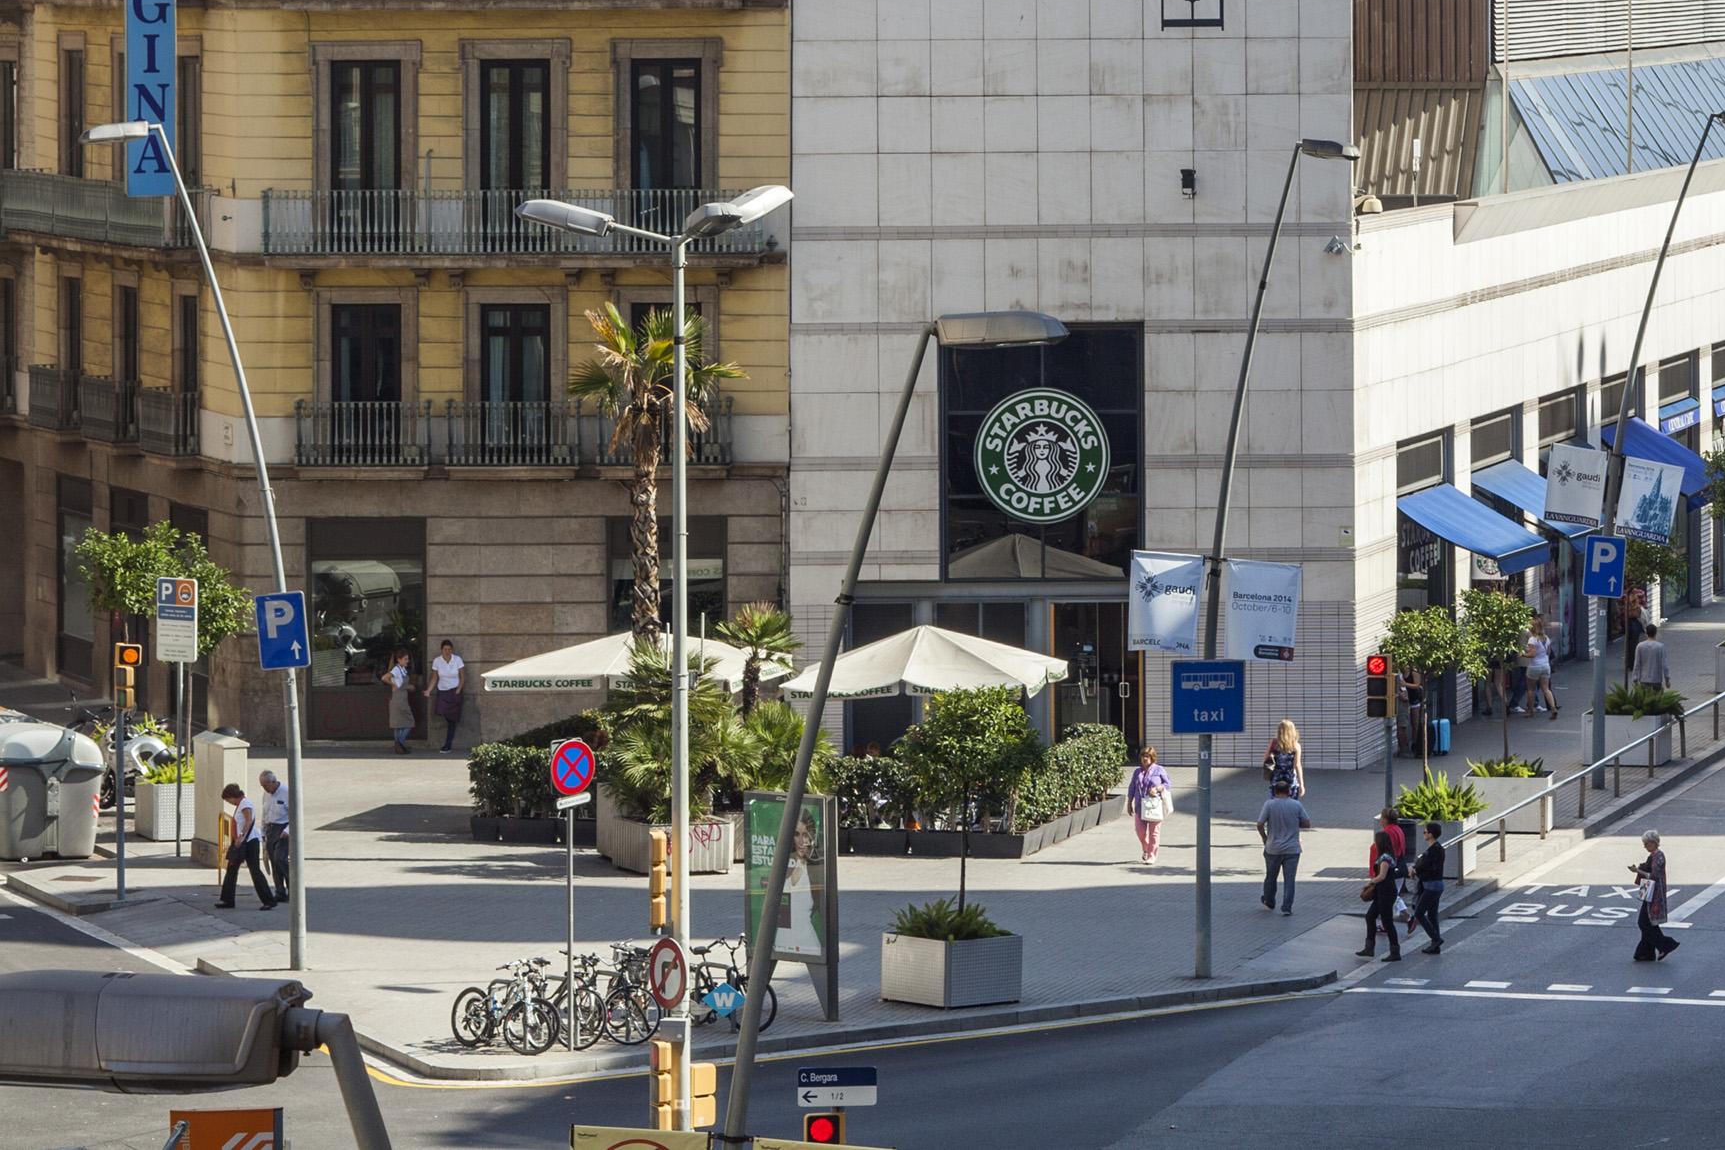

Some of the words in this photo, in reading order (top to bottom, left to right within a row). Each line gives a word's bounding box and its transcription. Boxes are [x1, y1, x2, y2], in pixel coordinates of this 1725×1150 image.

[985, 399, 1099, 452] STARBUCKS
[999, 482, 1086, 514] COFFEE
[1555, 514, 1598, 528] VANGUARDIA
[1626, 527, 1666, 543] VANGUARDIA
[1592, 542, 1617, 573] P
[161, 583, 173, 601] P
[1232, 591, 1272, 602] Barcelona
[1273, 594, 1292, 603] 2014
[264, 600, 294, 639] P
[491, 679, 552, 689] STARBUCKS
[555, 678, 593, 689] COFFEE
[790, 686, 849, 700] STAUCKS
[853, 685, 893, 697] COFFEE
[1193, 708, 1225, 722] taxi
[752, 834, 776, 846] PARA
[752, 845, 777, 856] ESTA
[1496, 902, 1639, 919] BUS
[714, 992, 736, 1007] W
[800, 1073, 808, 1082] C.
[810, 1073, 838, 1084] Bergara
